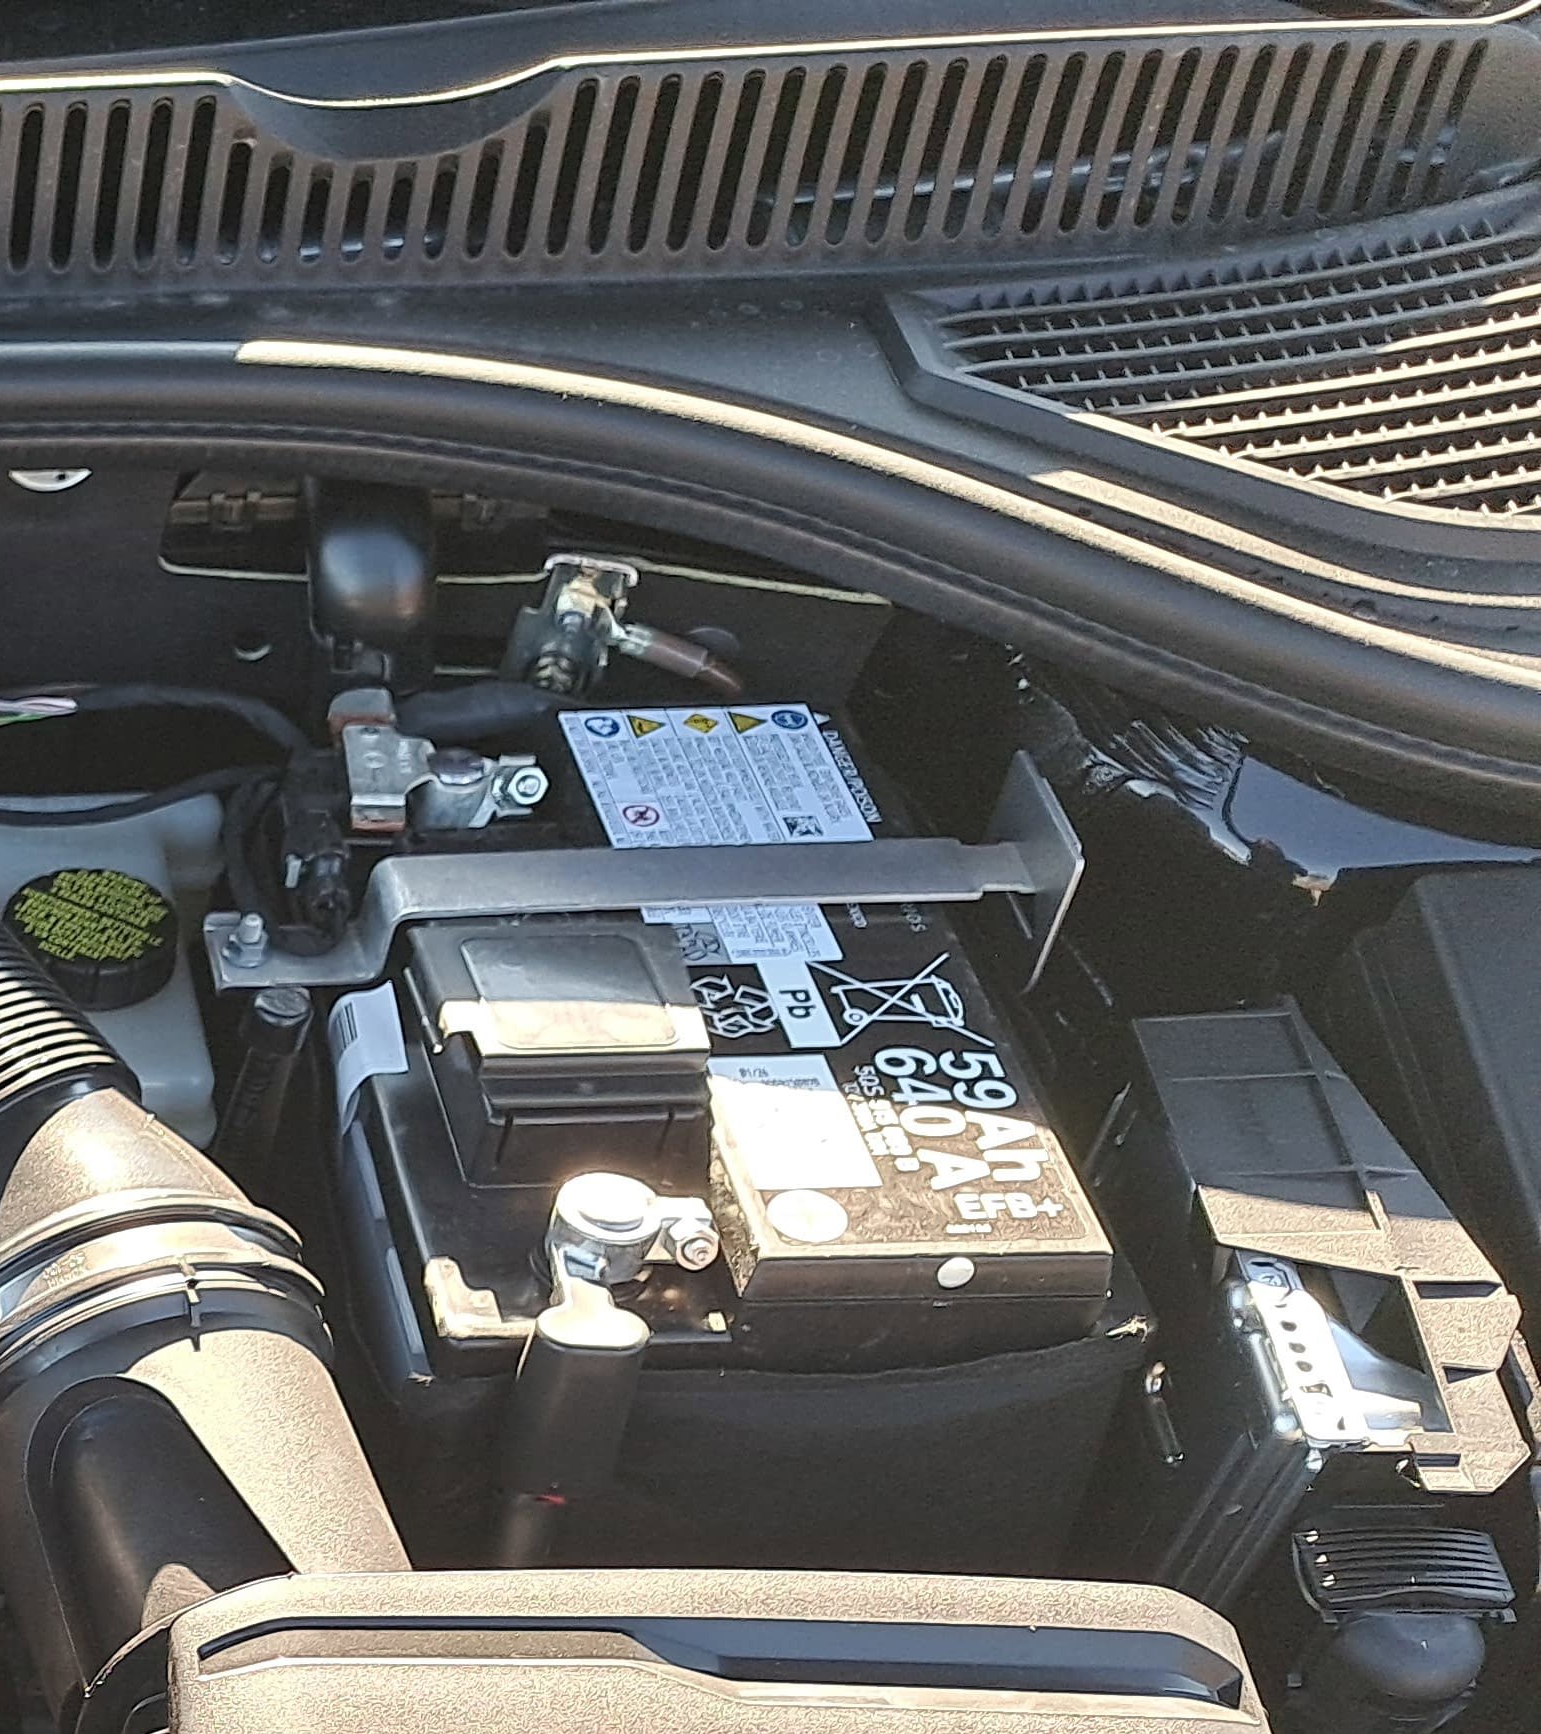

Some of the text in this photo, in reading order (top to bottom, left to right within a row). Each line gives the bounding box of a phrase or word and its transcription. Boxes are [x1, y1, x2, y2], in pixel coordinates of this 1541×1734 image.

[777, 987, 813, 1020] Pb
[873, 1046, 968, 1138] 640
[916, 1148, 991, 1191] A
[952, 1191, 1064, 1221] EFB+
